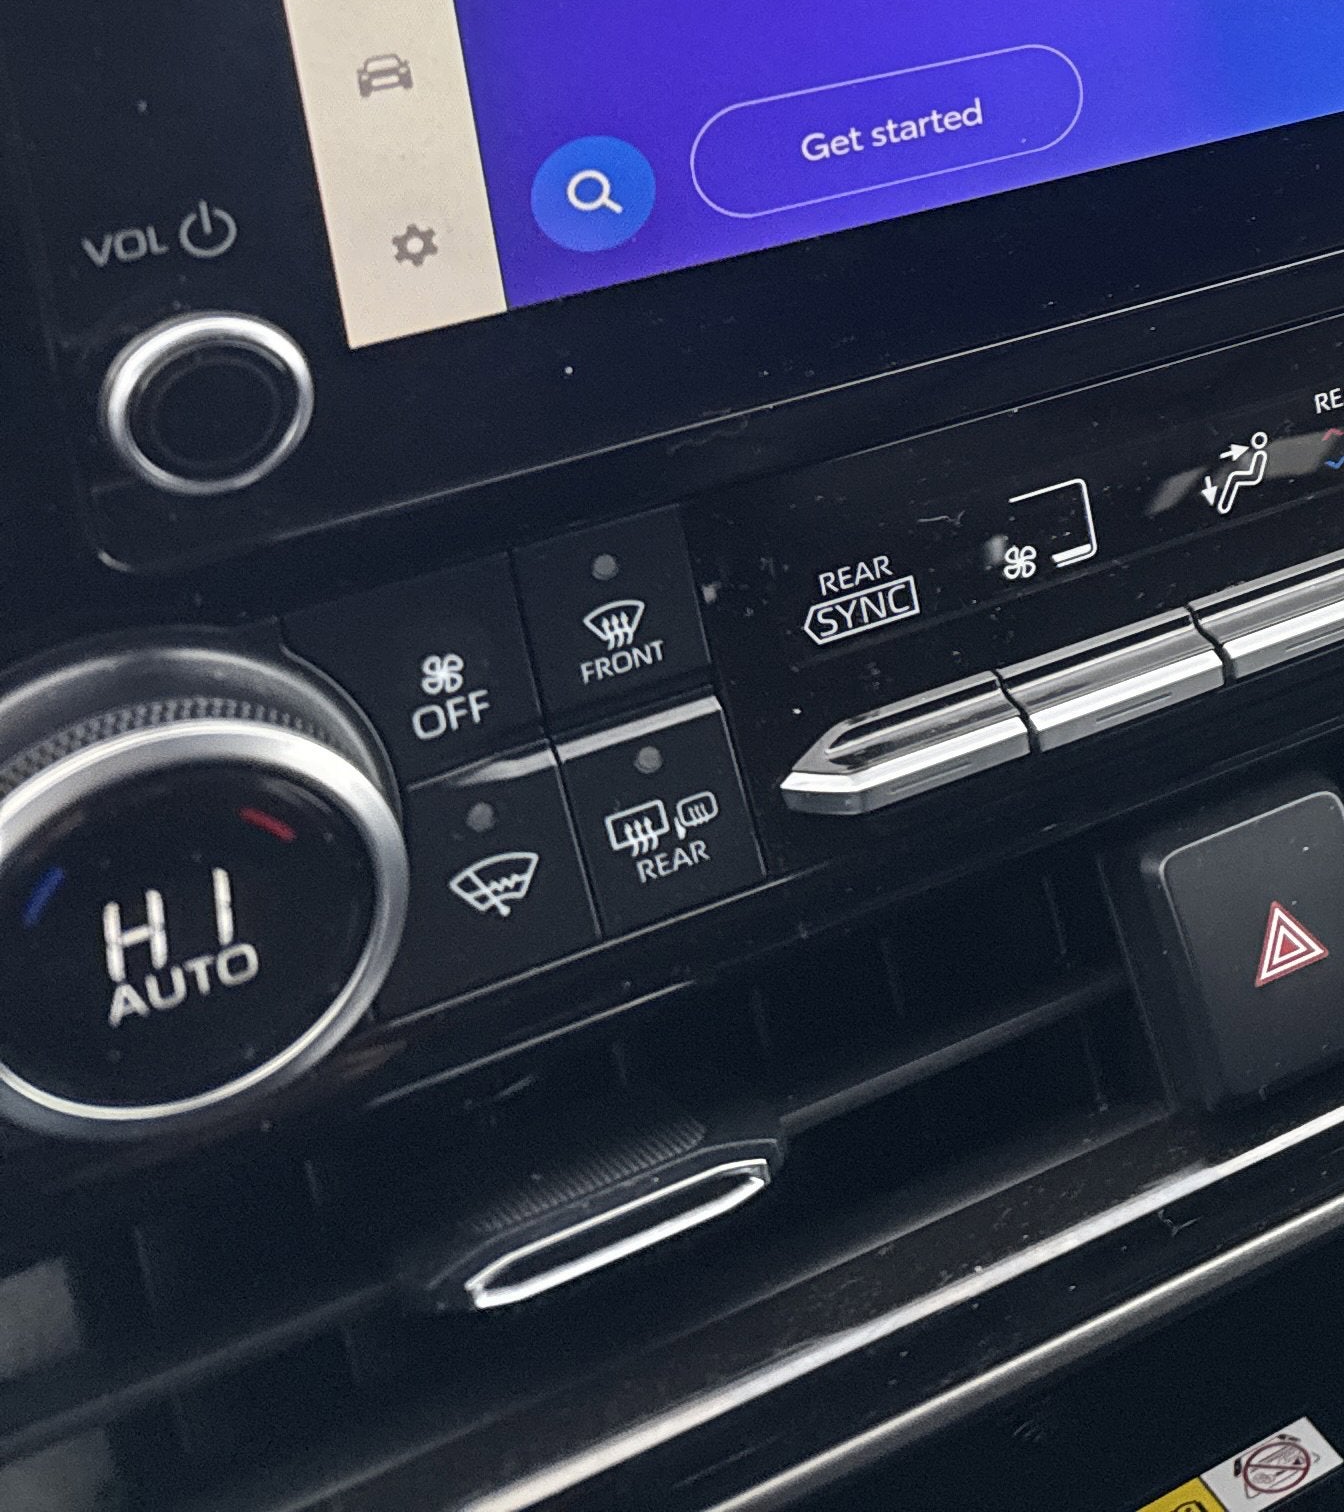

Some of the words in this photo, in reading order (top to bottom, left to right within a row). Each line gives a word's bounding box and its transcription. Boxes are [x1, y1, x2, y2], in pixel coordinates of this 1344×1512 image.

[800, 126, 865, 163] Get
[870, 96, 984, 148] started
[80, 225, 169, 269] VOL
[818, 554, 894, 598] REAR
[815, 581, 913, 639] SYNC
[578, 638, 666, 685] FRONT
[410, 689, 492, 743] OFF
[635, 838, 712, 884] REAR
[102, 866, 235, 984] HI
[107, 941, 260, 1028] AUTO
